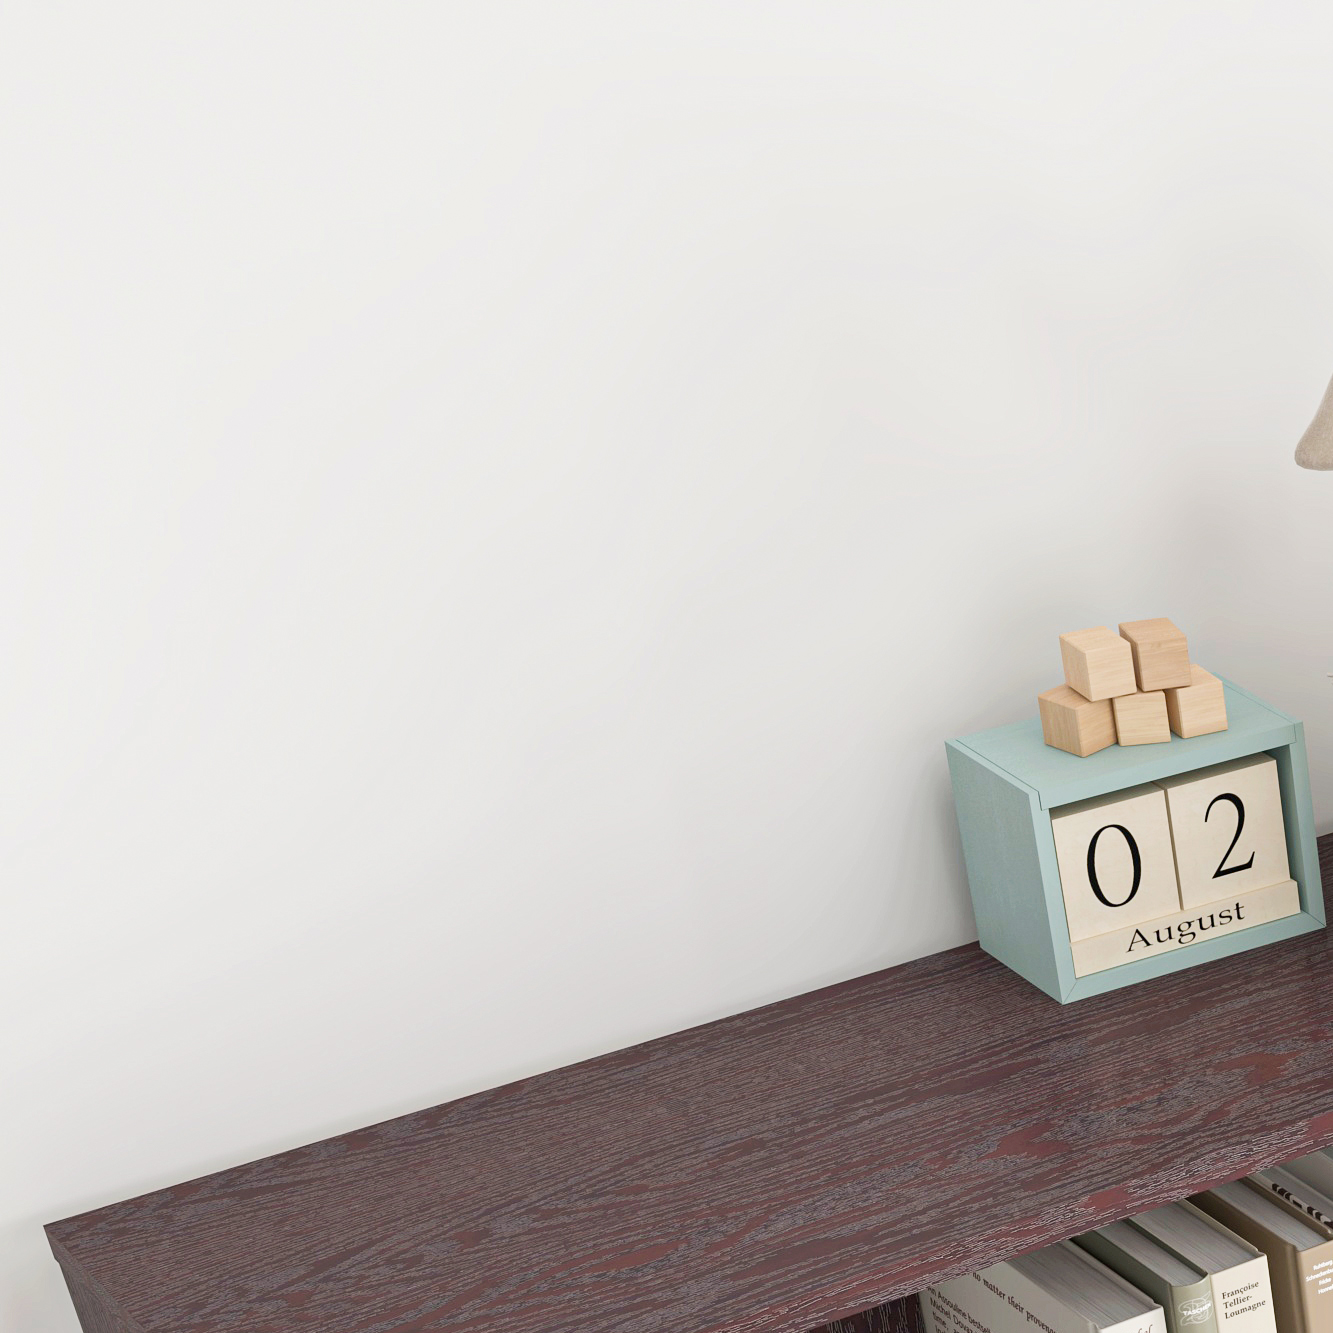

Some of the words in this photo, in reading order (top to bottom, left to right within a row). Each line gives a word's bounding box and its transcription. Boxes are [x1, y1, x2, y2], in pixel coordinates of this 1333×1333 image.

[1086, 824, 1142, 908] 0
[1204, 792, 1256, 880] 2
[1125, 902, 1246, 953] August
[983, 1280, 1006, 1300] matter
[1007, 1295, 1024, 1315] their
[1222, 1281, 1260, 1299] Françoise
[1223, 1295, 1253, 1309] Tellier-
[1224, 1300, 1266, 1320] Loumagne
